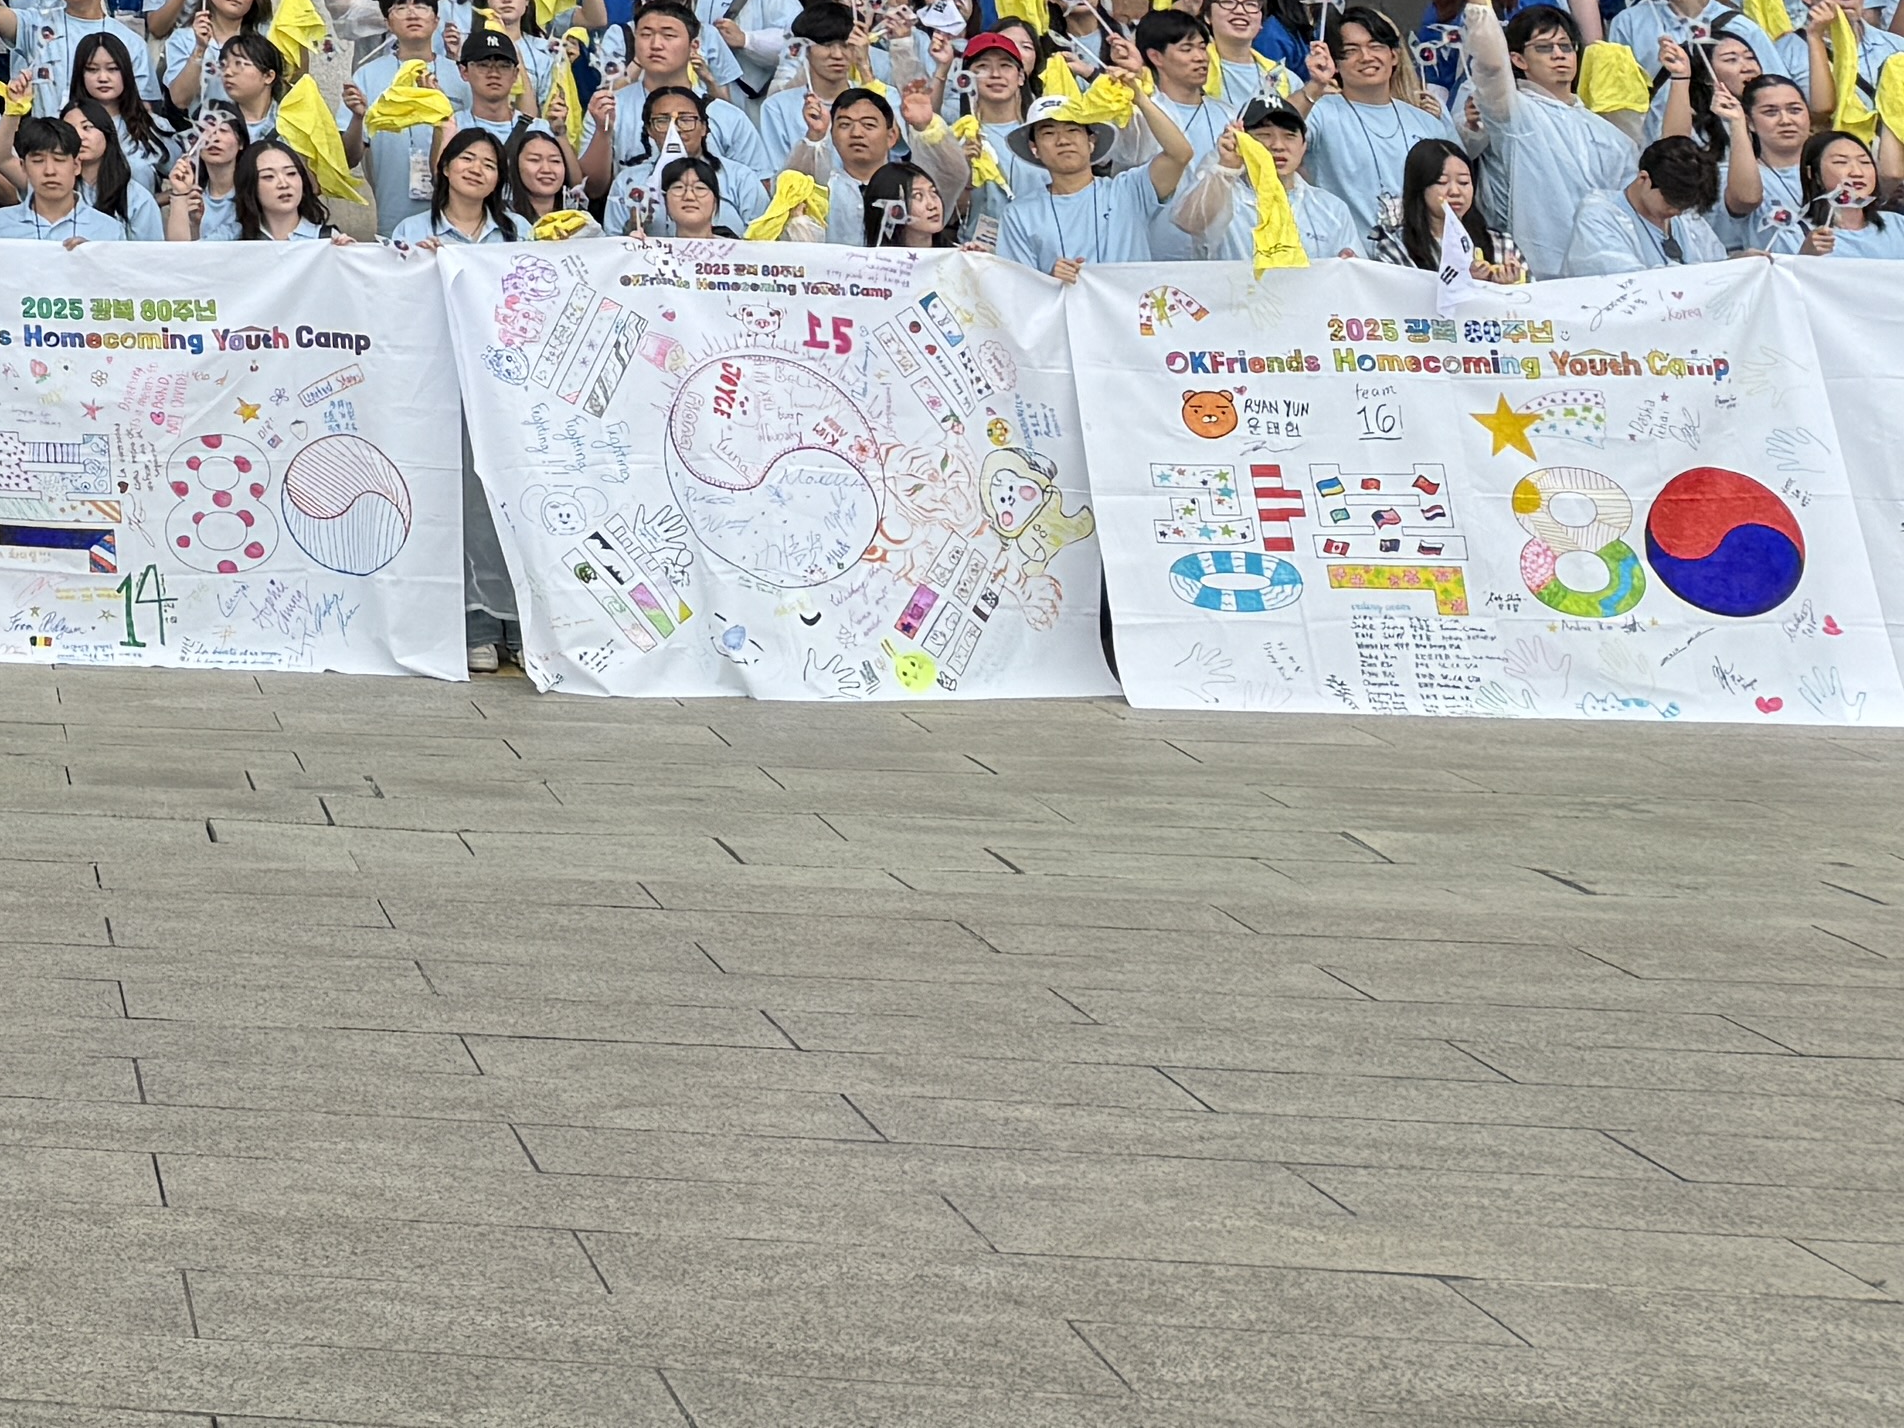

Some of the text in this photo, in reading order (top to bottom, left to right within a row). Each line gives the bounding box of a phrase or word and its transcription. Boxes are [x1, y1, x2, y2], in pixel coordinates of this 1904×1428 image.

[695, 262, 730, 276] 2025
[761, 264, 805, 279] 80주년
[696, 277, 798, 297] Homecoming
[802, 281, 846, 296] Youth
[849, 283, 893, 300] Camp
[21, 296, 218, 322] 2025 광복 80주년
[23, 323, 205, 355] Homecoming
[211, 325, 290, 352] Youth
[295, 325, 372, 356] Camp
[802, 309, 854, 355] 15
[1327, 318, 1555, 343] 2025 광복 80주년
[1165, 347, 1730, 381] OKFriends Homecoming Youth Camp
[713, 362, 742, 419] JOYCE
[1355, 383, 1398, 400] team
[1244, 398, 1310, 417] RYAN YUN
[116, 564, 179, 648] 14
